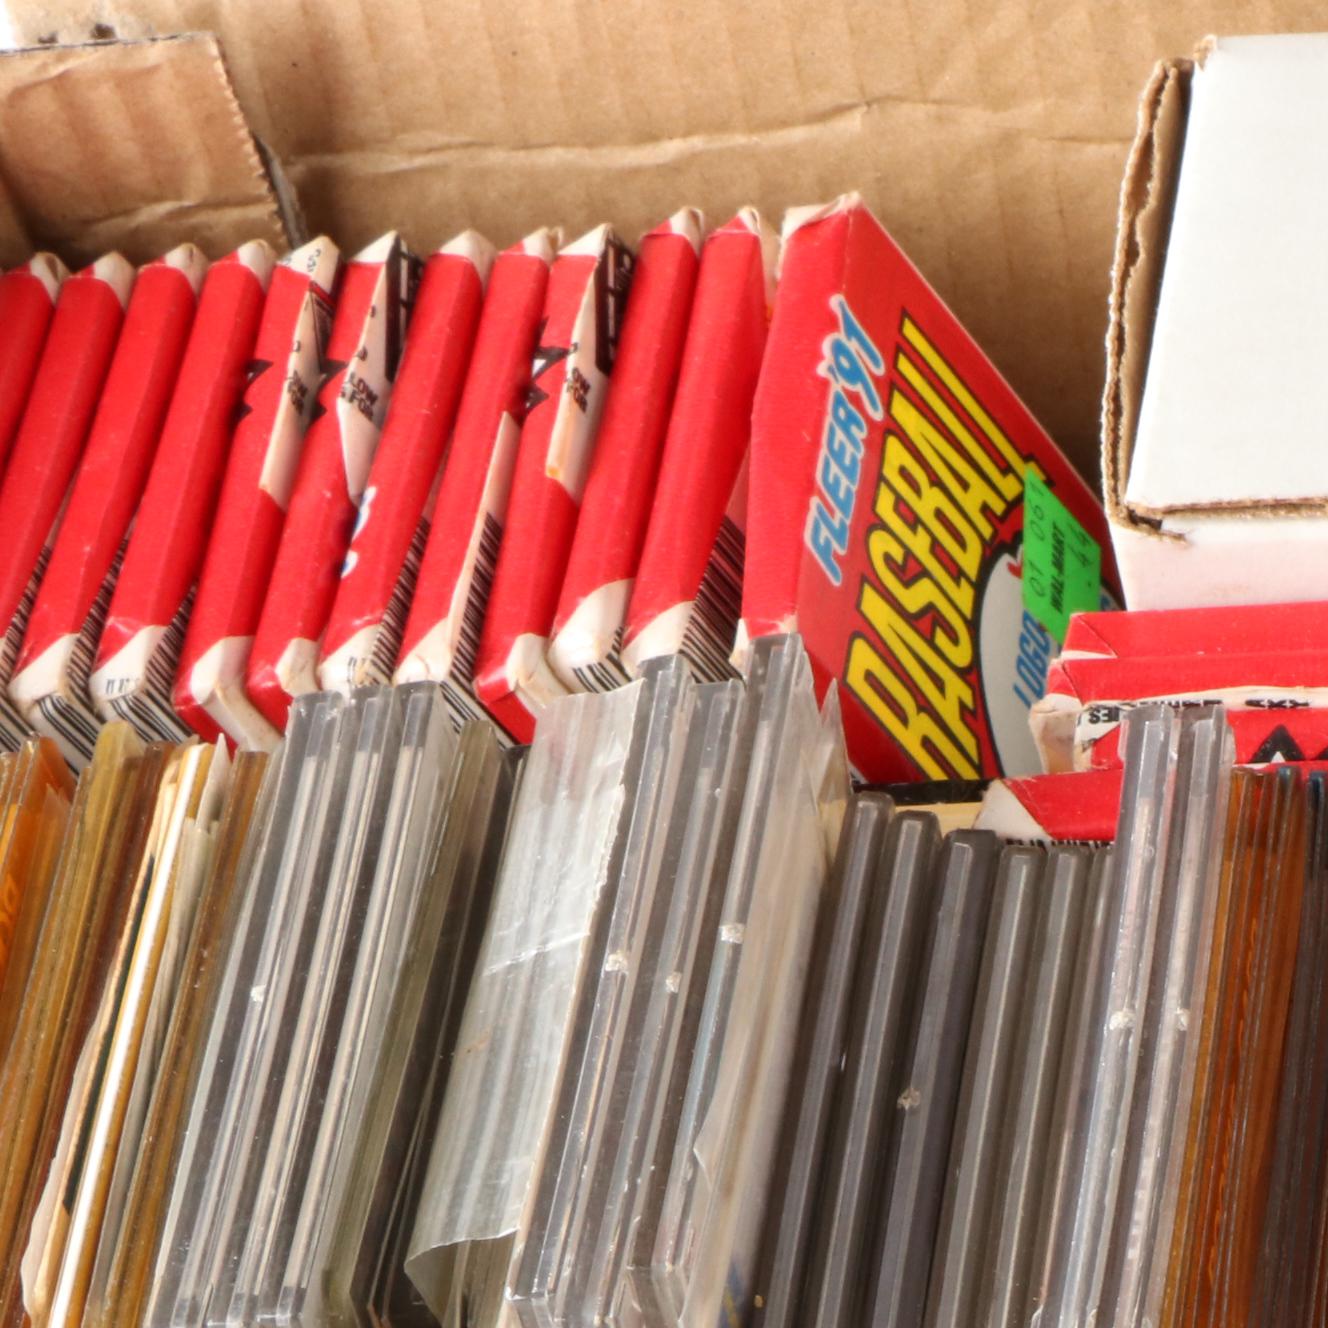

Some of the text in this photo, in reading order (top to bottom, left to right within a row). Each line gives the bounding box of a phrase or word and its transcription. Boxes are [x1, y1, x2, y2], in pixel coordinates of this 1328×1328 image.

[806, 392, 867, 586] FLEER
[843, 308, 1056, 780] BASEBALL
[1050, 520, 1066, 616] WAL-MART
